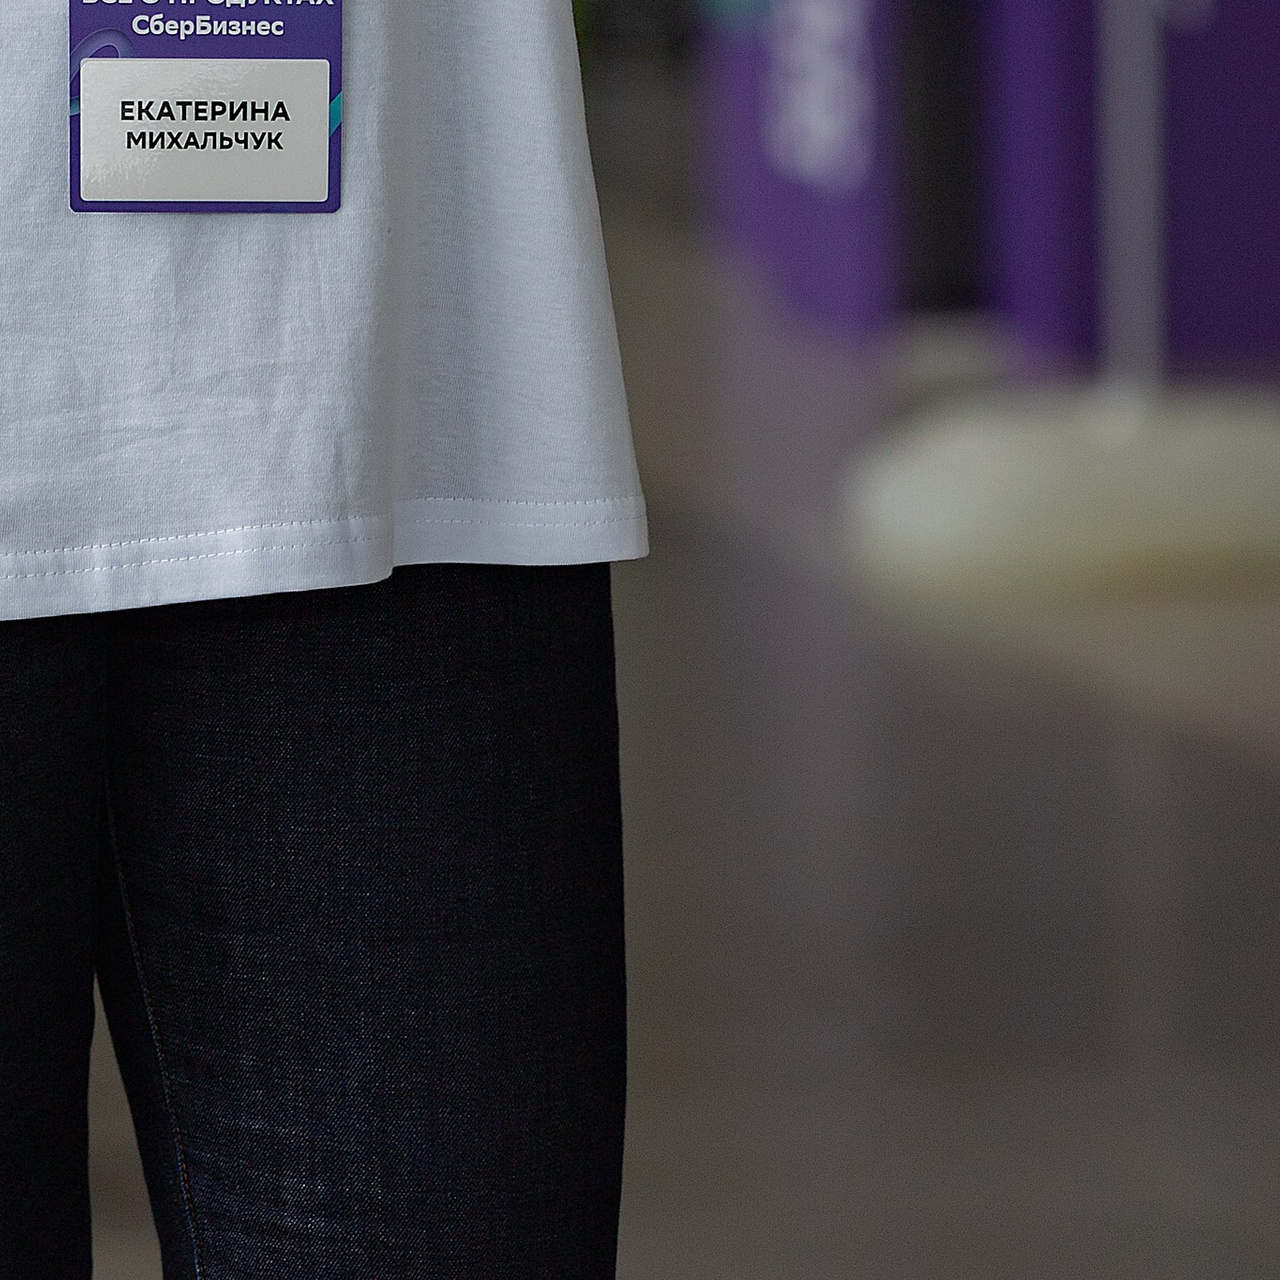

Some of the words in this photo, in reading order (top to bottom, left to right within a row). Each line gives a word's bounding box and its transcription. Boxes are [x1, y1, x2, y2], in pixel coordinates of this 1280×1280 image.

[131, 14, 284, 39] СберБизнес
[120, 100, 291, 122] ЕКАТЕРИНА
[125, 131, 284, 150] МИХАЛЬЧУК
